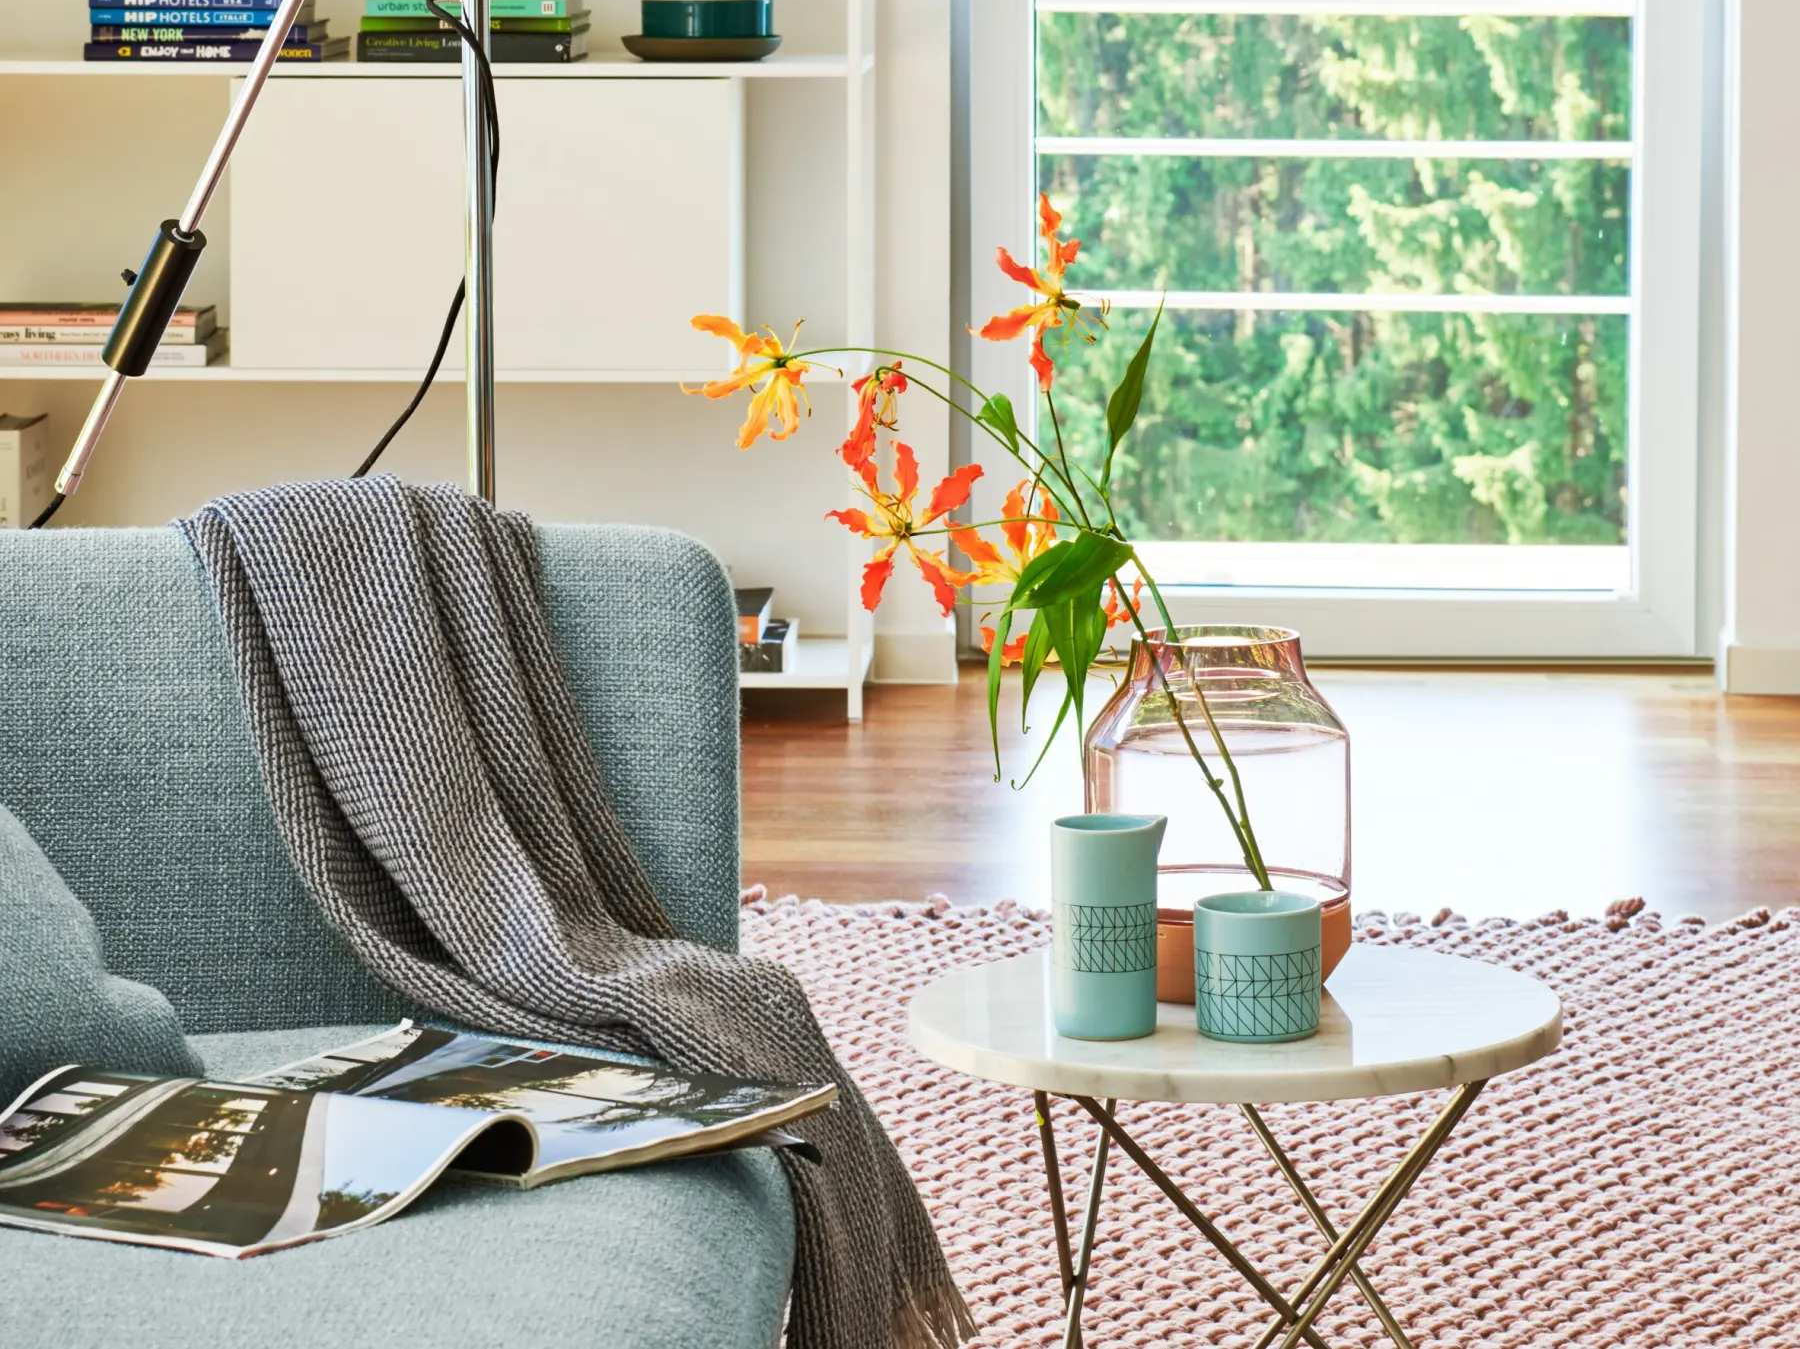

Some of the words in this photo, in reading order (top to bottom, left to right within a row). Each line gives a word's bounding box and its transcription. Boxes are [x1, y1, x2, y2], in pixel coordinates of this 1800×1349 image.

[377, 1, 410, 12] urban
[124, 11, 158, 23] HIP
[159, 12, 211, 23] HOTELS
[121, 28, 149, 41] NEW
[152, 28, 184, 41] YORK
[365, 37, 407, 47] Creative
[409, 37, 440, 49] Living
[140, 46, 180, 58] ENJOY
[195, 45, 231, 58] HOME
[25, 327, 55, 343] living
